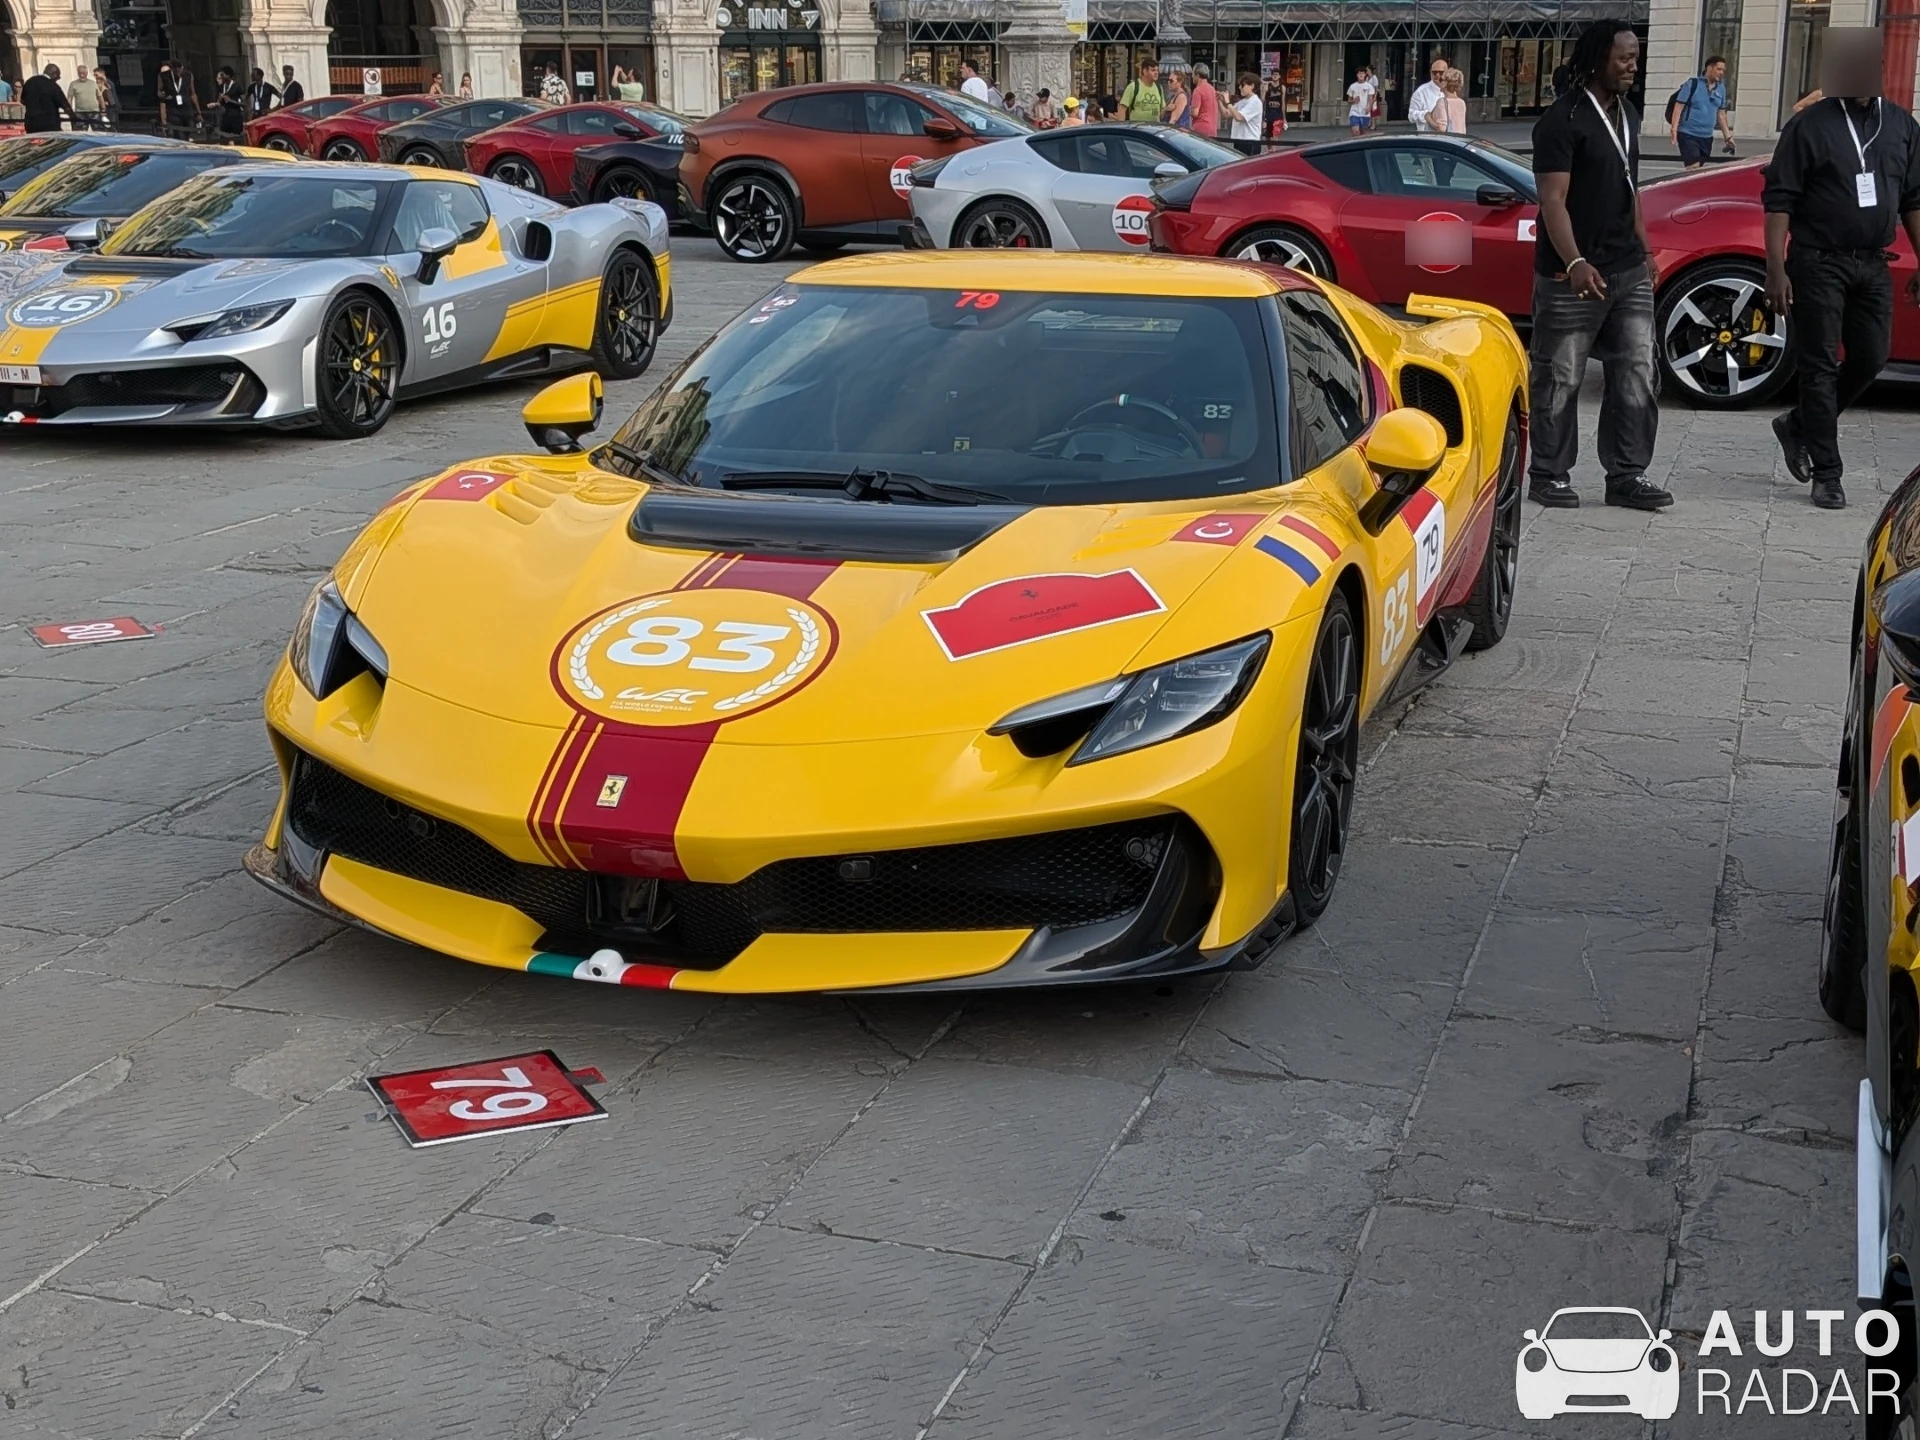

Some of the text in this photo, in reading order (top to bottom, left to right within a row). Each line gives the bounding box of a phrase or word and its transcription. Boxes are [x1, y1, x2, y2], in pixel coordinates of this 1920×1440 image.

[747, 7, 788, 30] INN
[1114, 213, 1144, 231] 10
[26, 294, 101, 312] 16
[955, 291, 1000, 309] 79
[422, 301, 457, 344] 16
[1203, 403, 1232, 419] 83
[1422, 524, 1439, 584] 79
[1380, 568, 1410, 666] 83
[59, 622, 123, 640] 80
[606, 616, 792, 673] 83
[615, 686, 709, 704] WEC
[429, 1066, 549, 1120] 79
